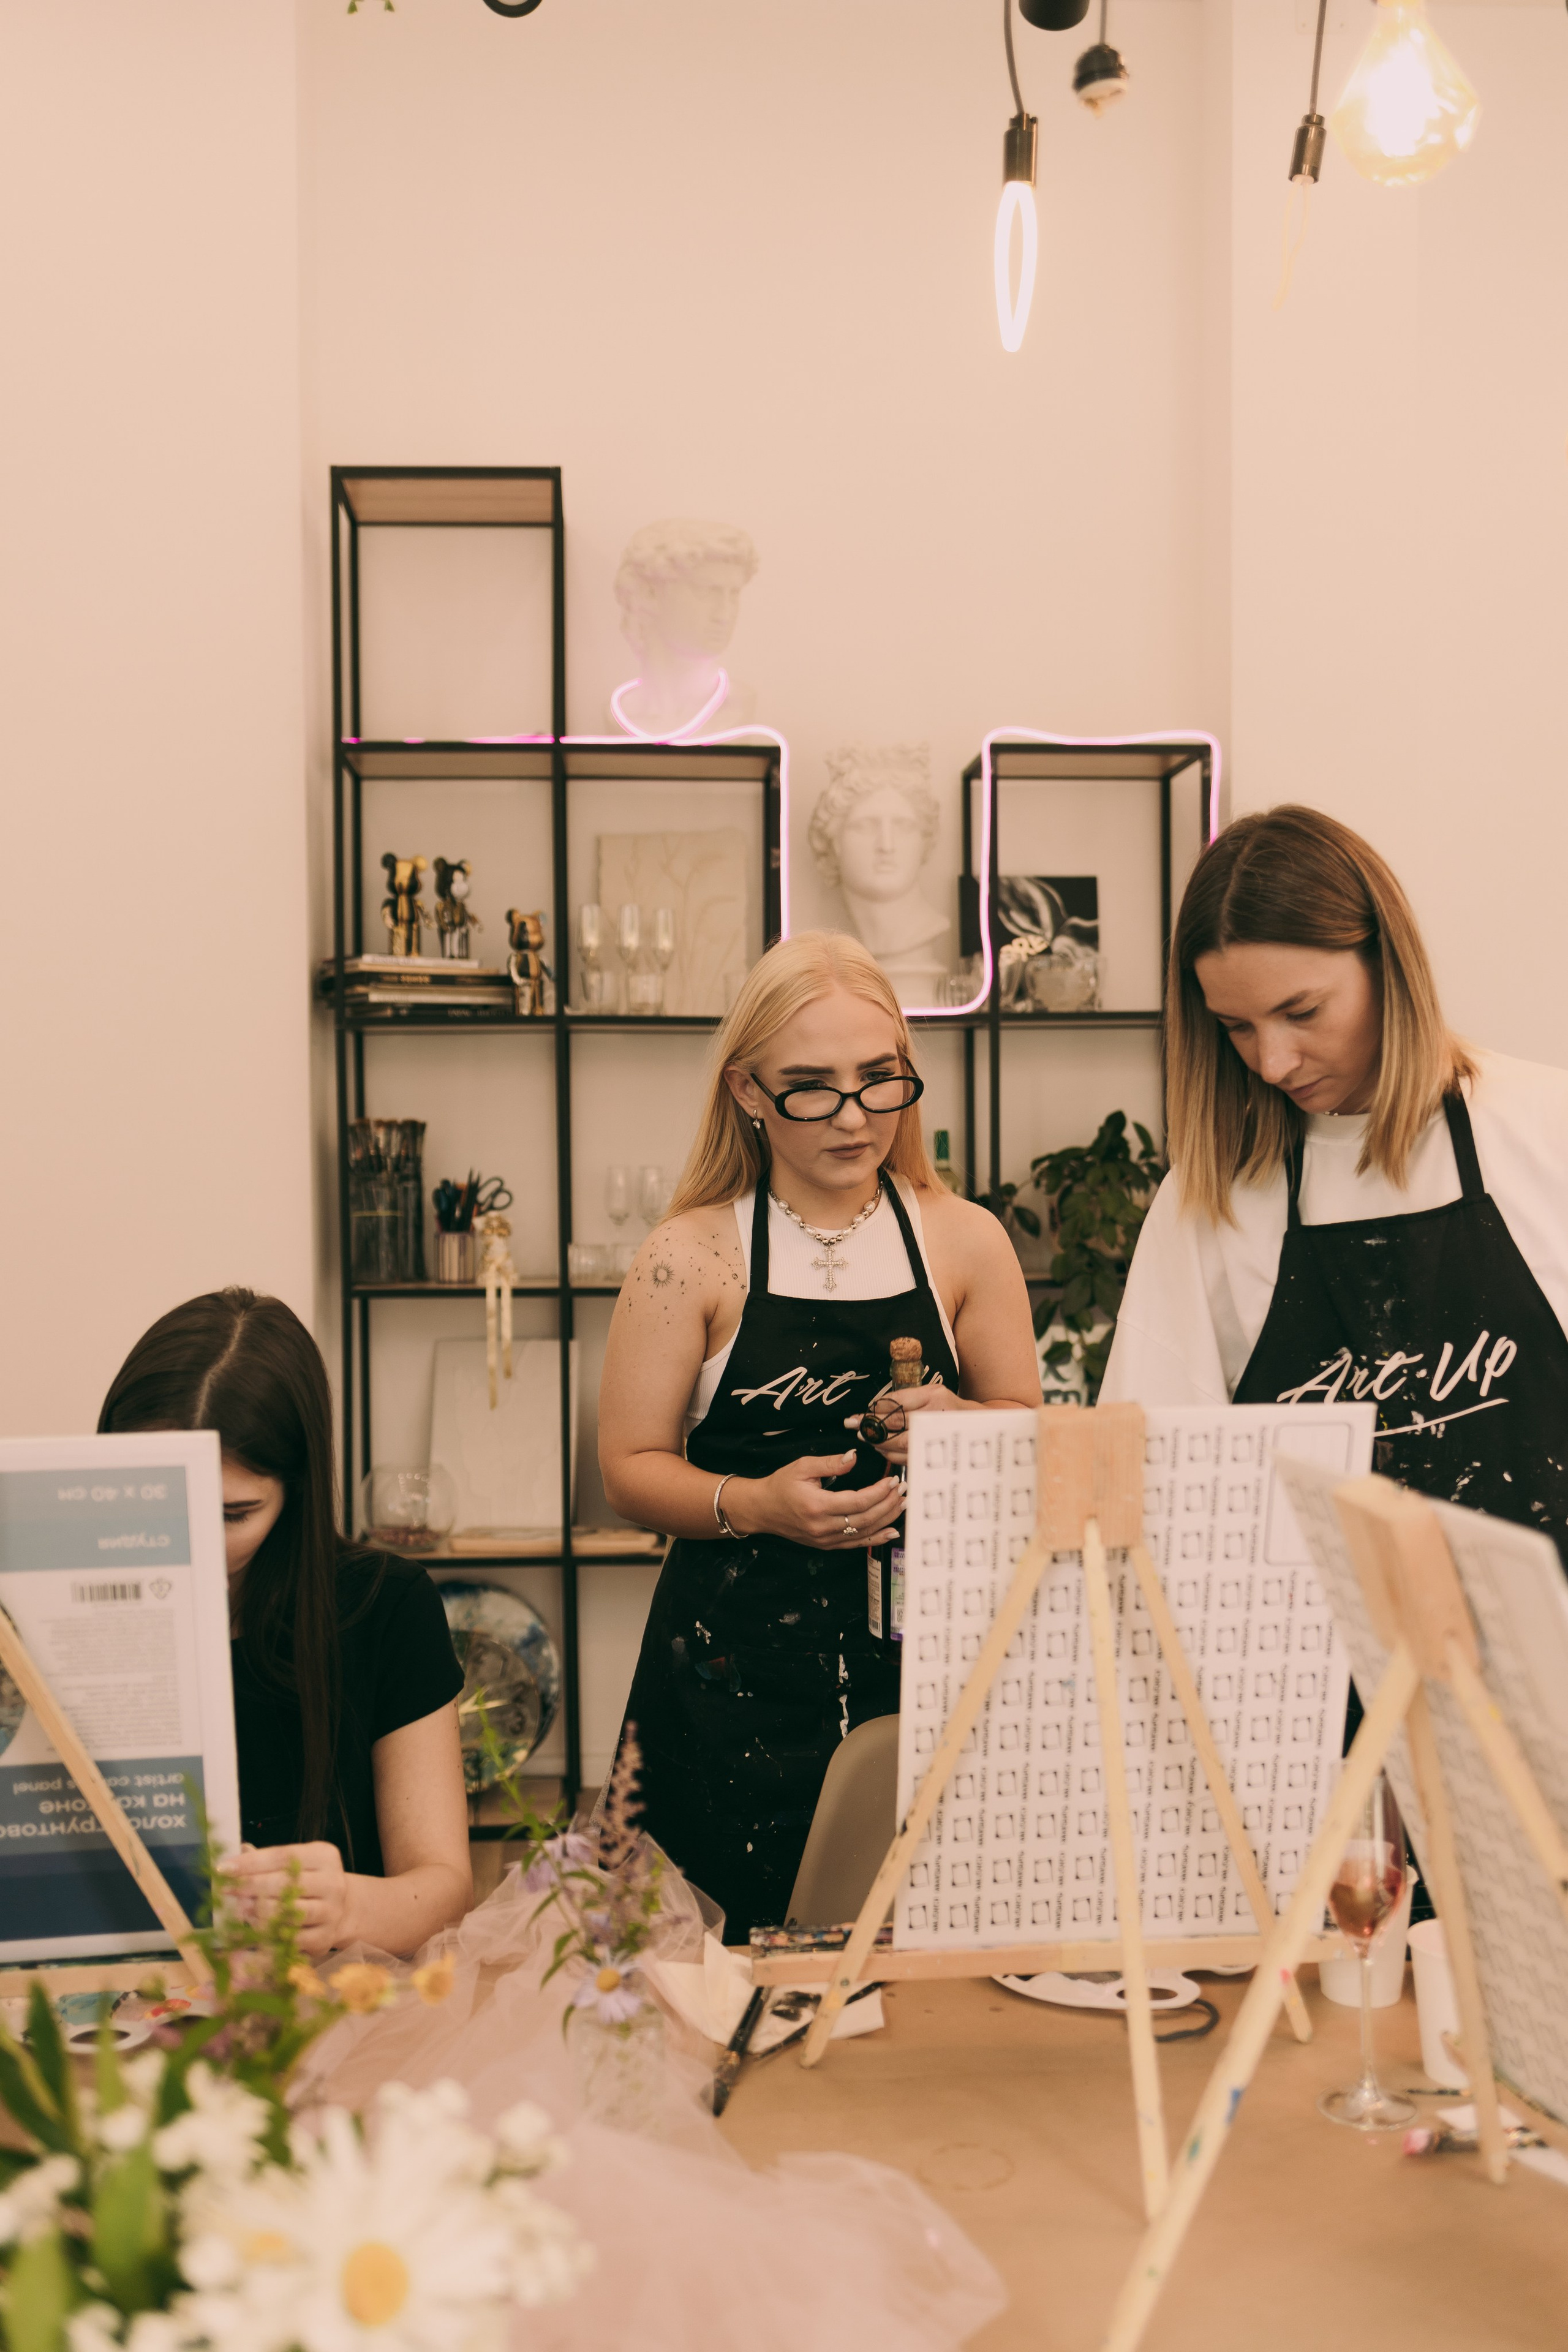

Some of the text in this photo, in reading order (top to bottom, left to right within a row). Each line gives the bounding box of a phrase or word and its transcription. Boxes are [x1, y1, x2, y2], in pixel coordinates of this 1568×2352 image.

[1276, 1350, 1423, 1404] Art
[731, 1366, 870, 1411] Art
[91, 1485, 119, 1501] 40
[140, 1483, 166, 1500] 30
[97, 1532, 171, 1550] студия
[13, 1777, 62, 1795] panel
[134, 1773, 184, 1787] artist
[153, 1793, 186, 1807] на
